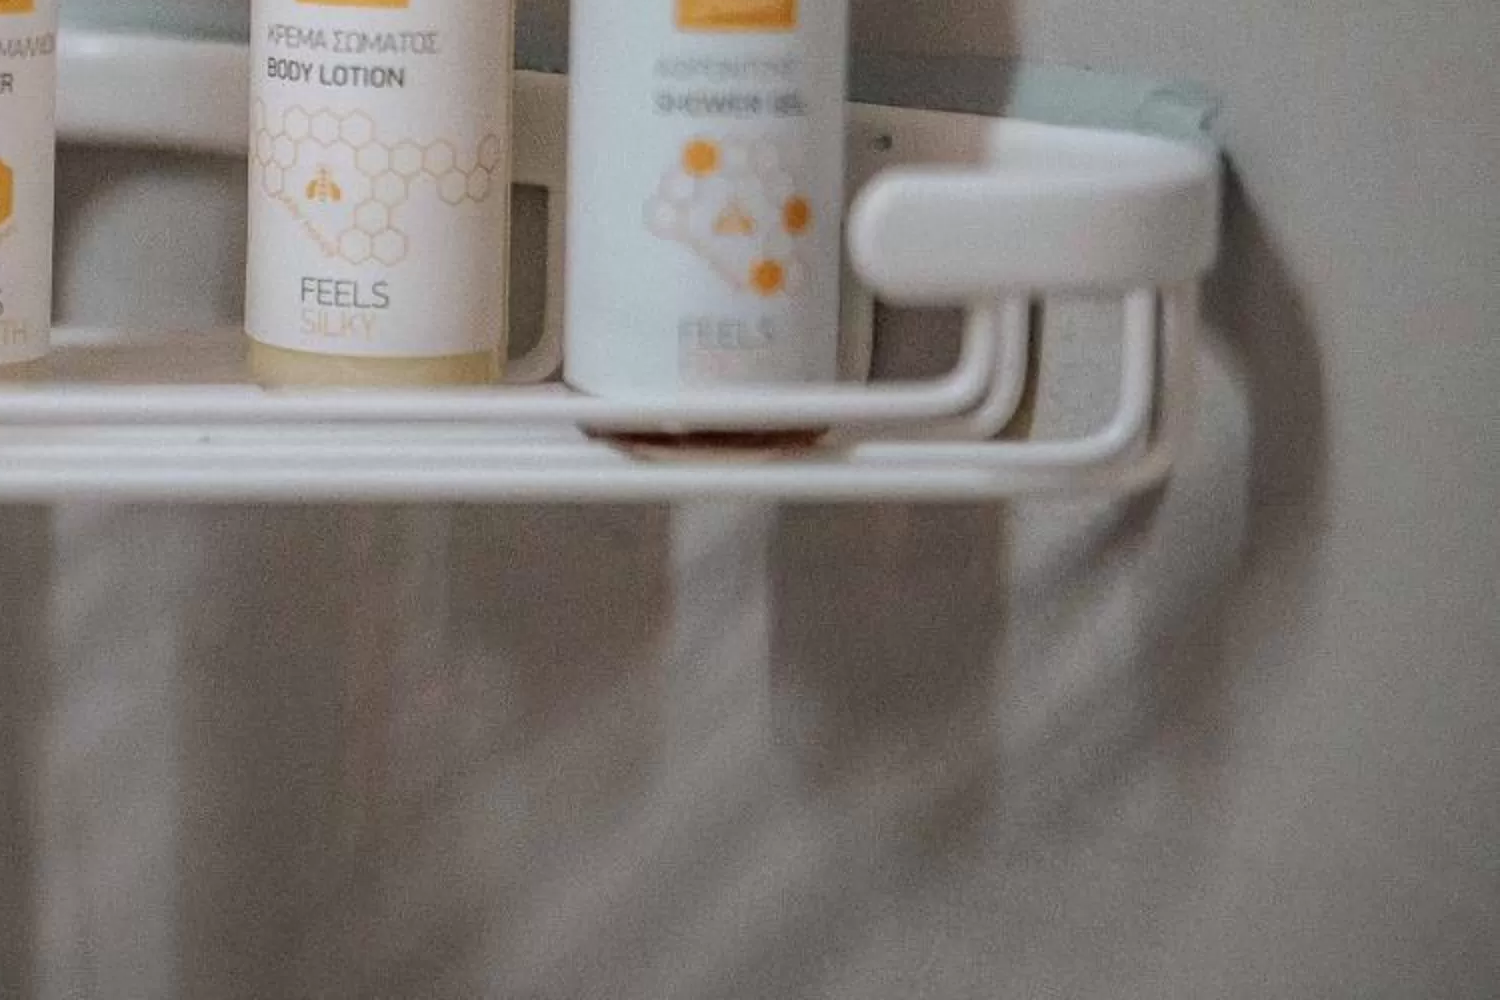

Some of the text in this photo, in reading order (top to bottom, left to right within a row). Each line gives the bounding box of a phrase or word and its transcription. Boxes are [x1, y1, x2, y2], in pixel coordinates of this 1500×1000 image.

[267, 56, 406, 89] BODY LOTION
[301, 276, 390, 309] FEELS
